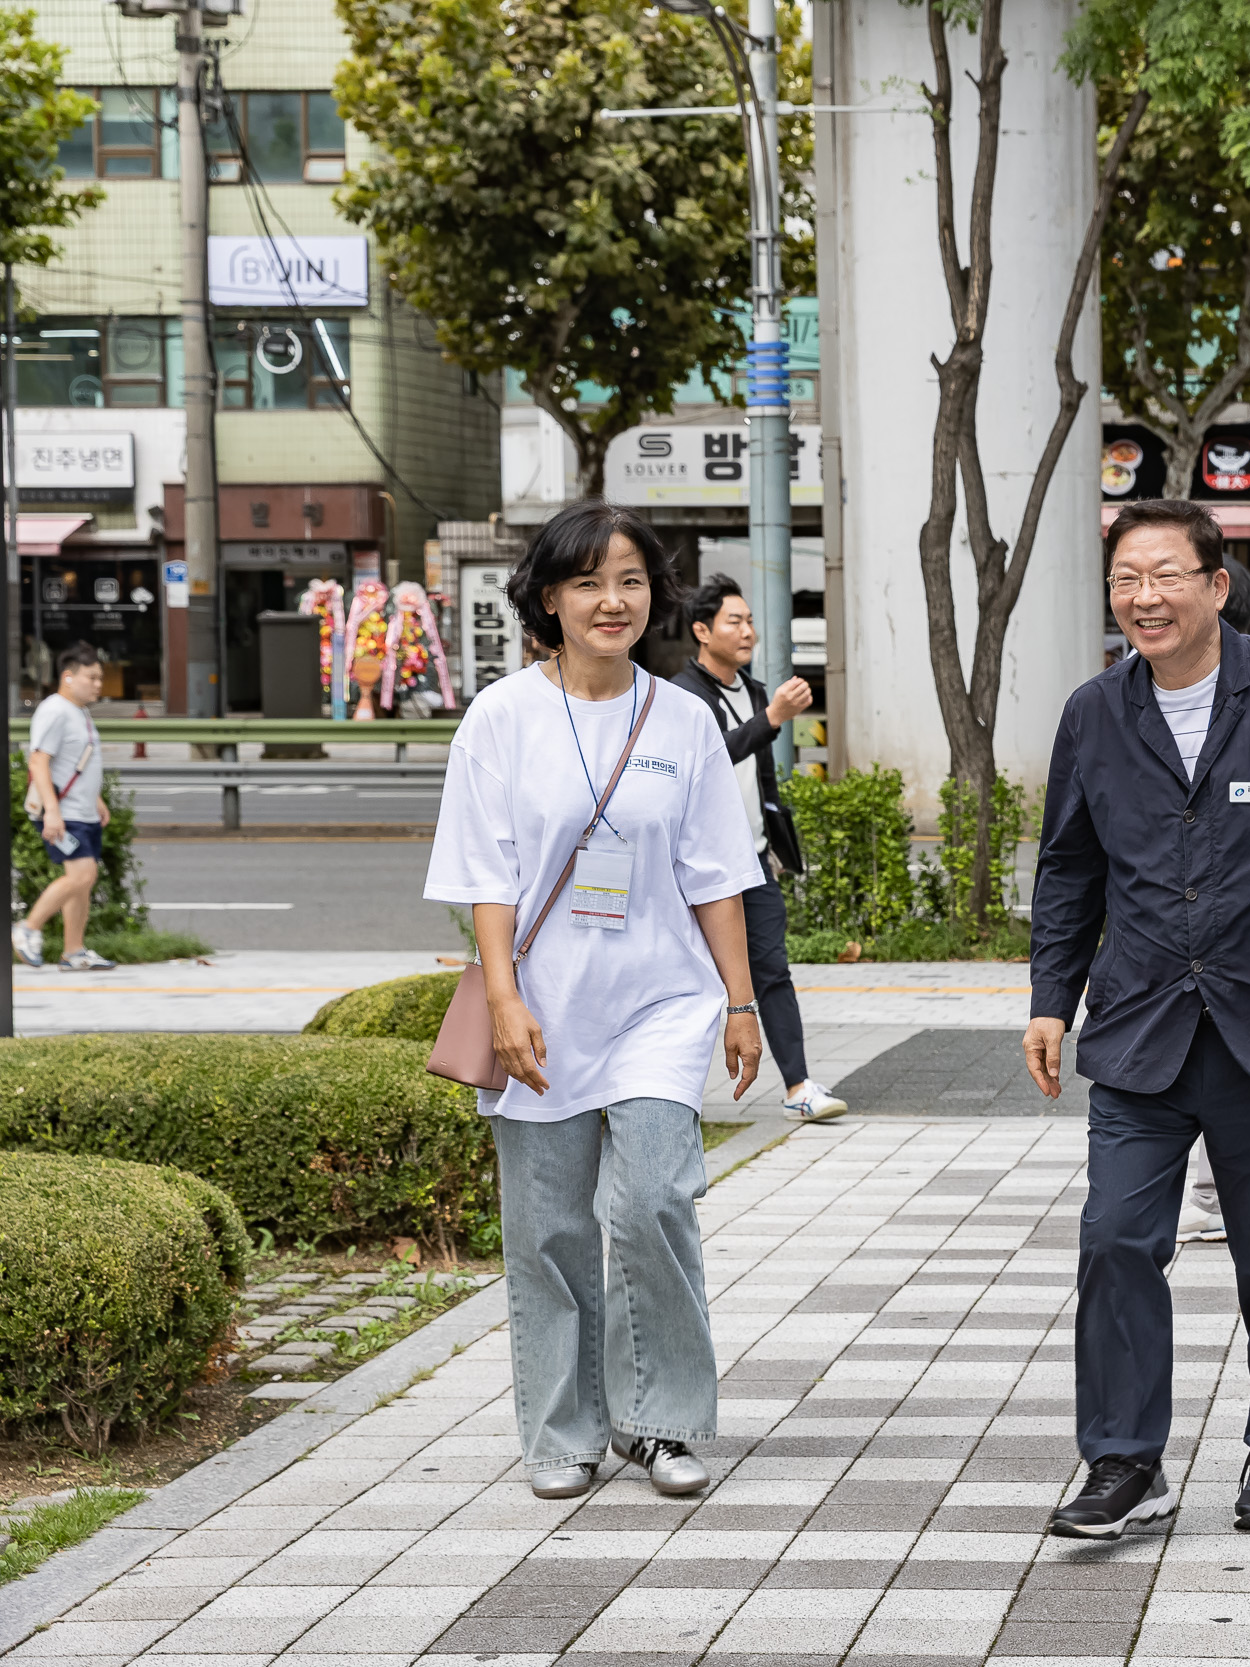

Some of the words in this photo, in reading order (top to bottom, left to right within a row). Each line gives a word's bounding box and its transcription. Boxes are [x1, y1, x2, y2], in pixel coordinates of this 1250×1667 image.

[32, 447, 123, 472] 진주냉면
[624, 463, 688, 477] SOLVER
[652, 760, 676, 774] 편의점
